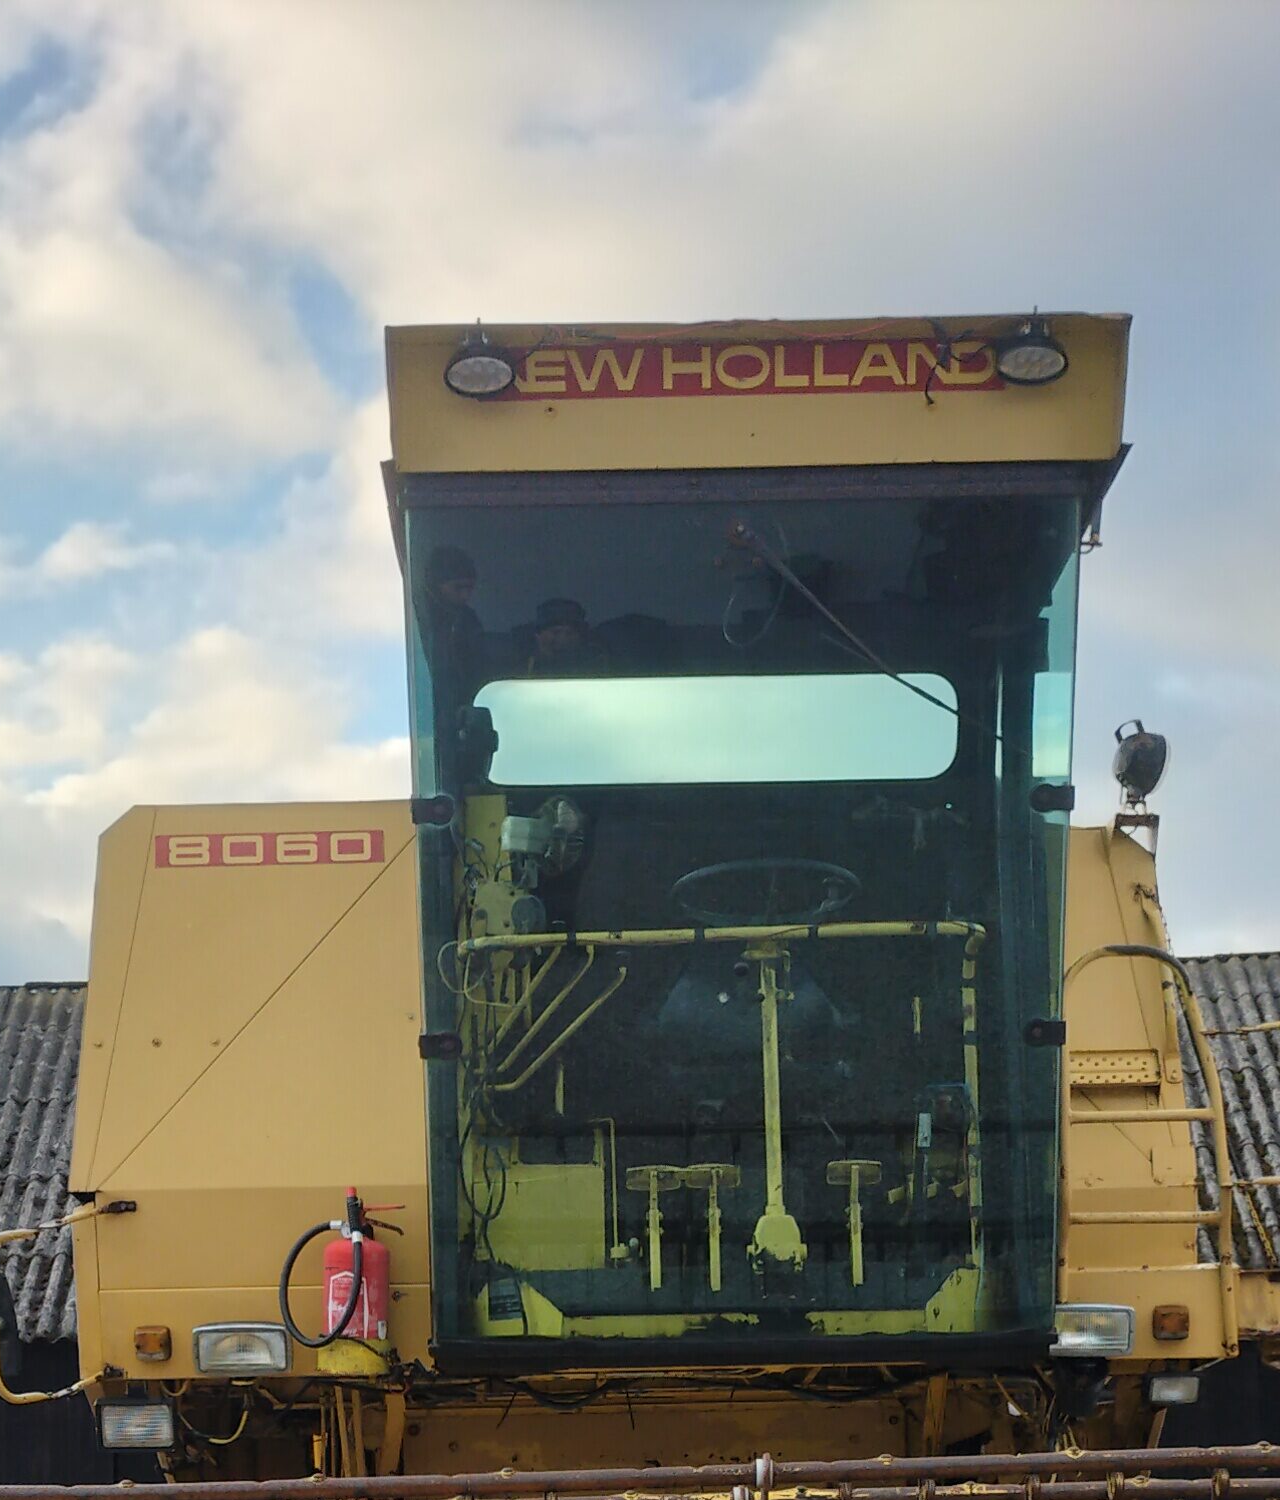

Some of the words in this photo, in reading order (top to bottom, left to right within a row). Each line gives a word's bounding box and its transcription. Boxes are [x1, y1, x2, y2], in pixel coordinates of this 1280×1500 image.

[514, 348, 645, 393] EW
[662, 341, 997, 390] HOLLAND
[168, 831, 372, 866] 8060
